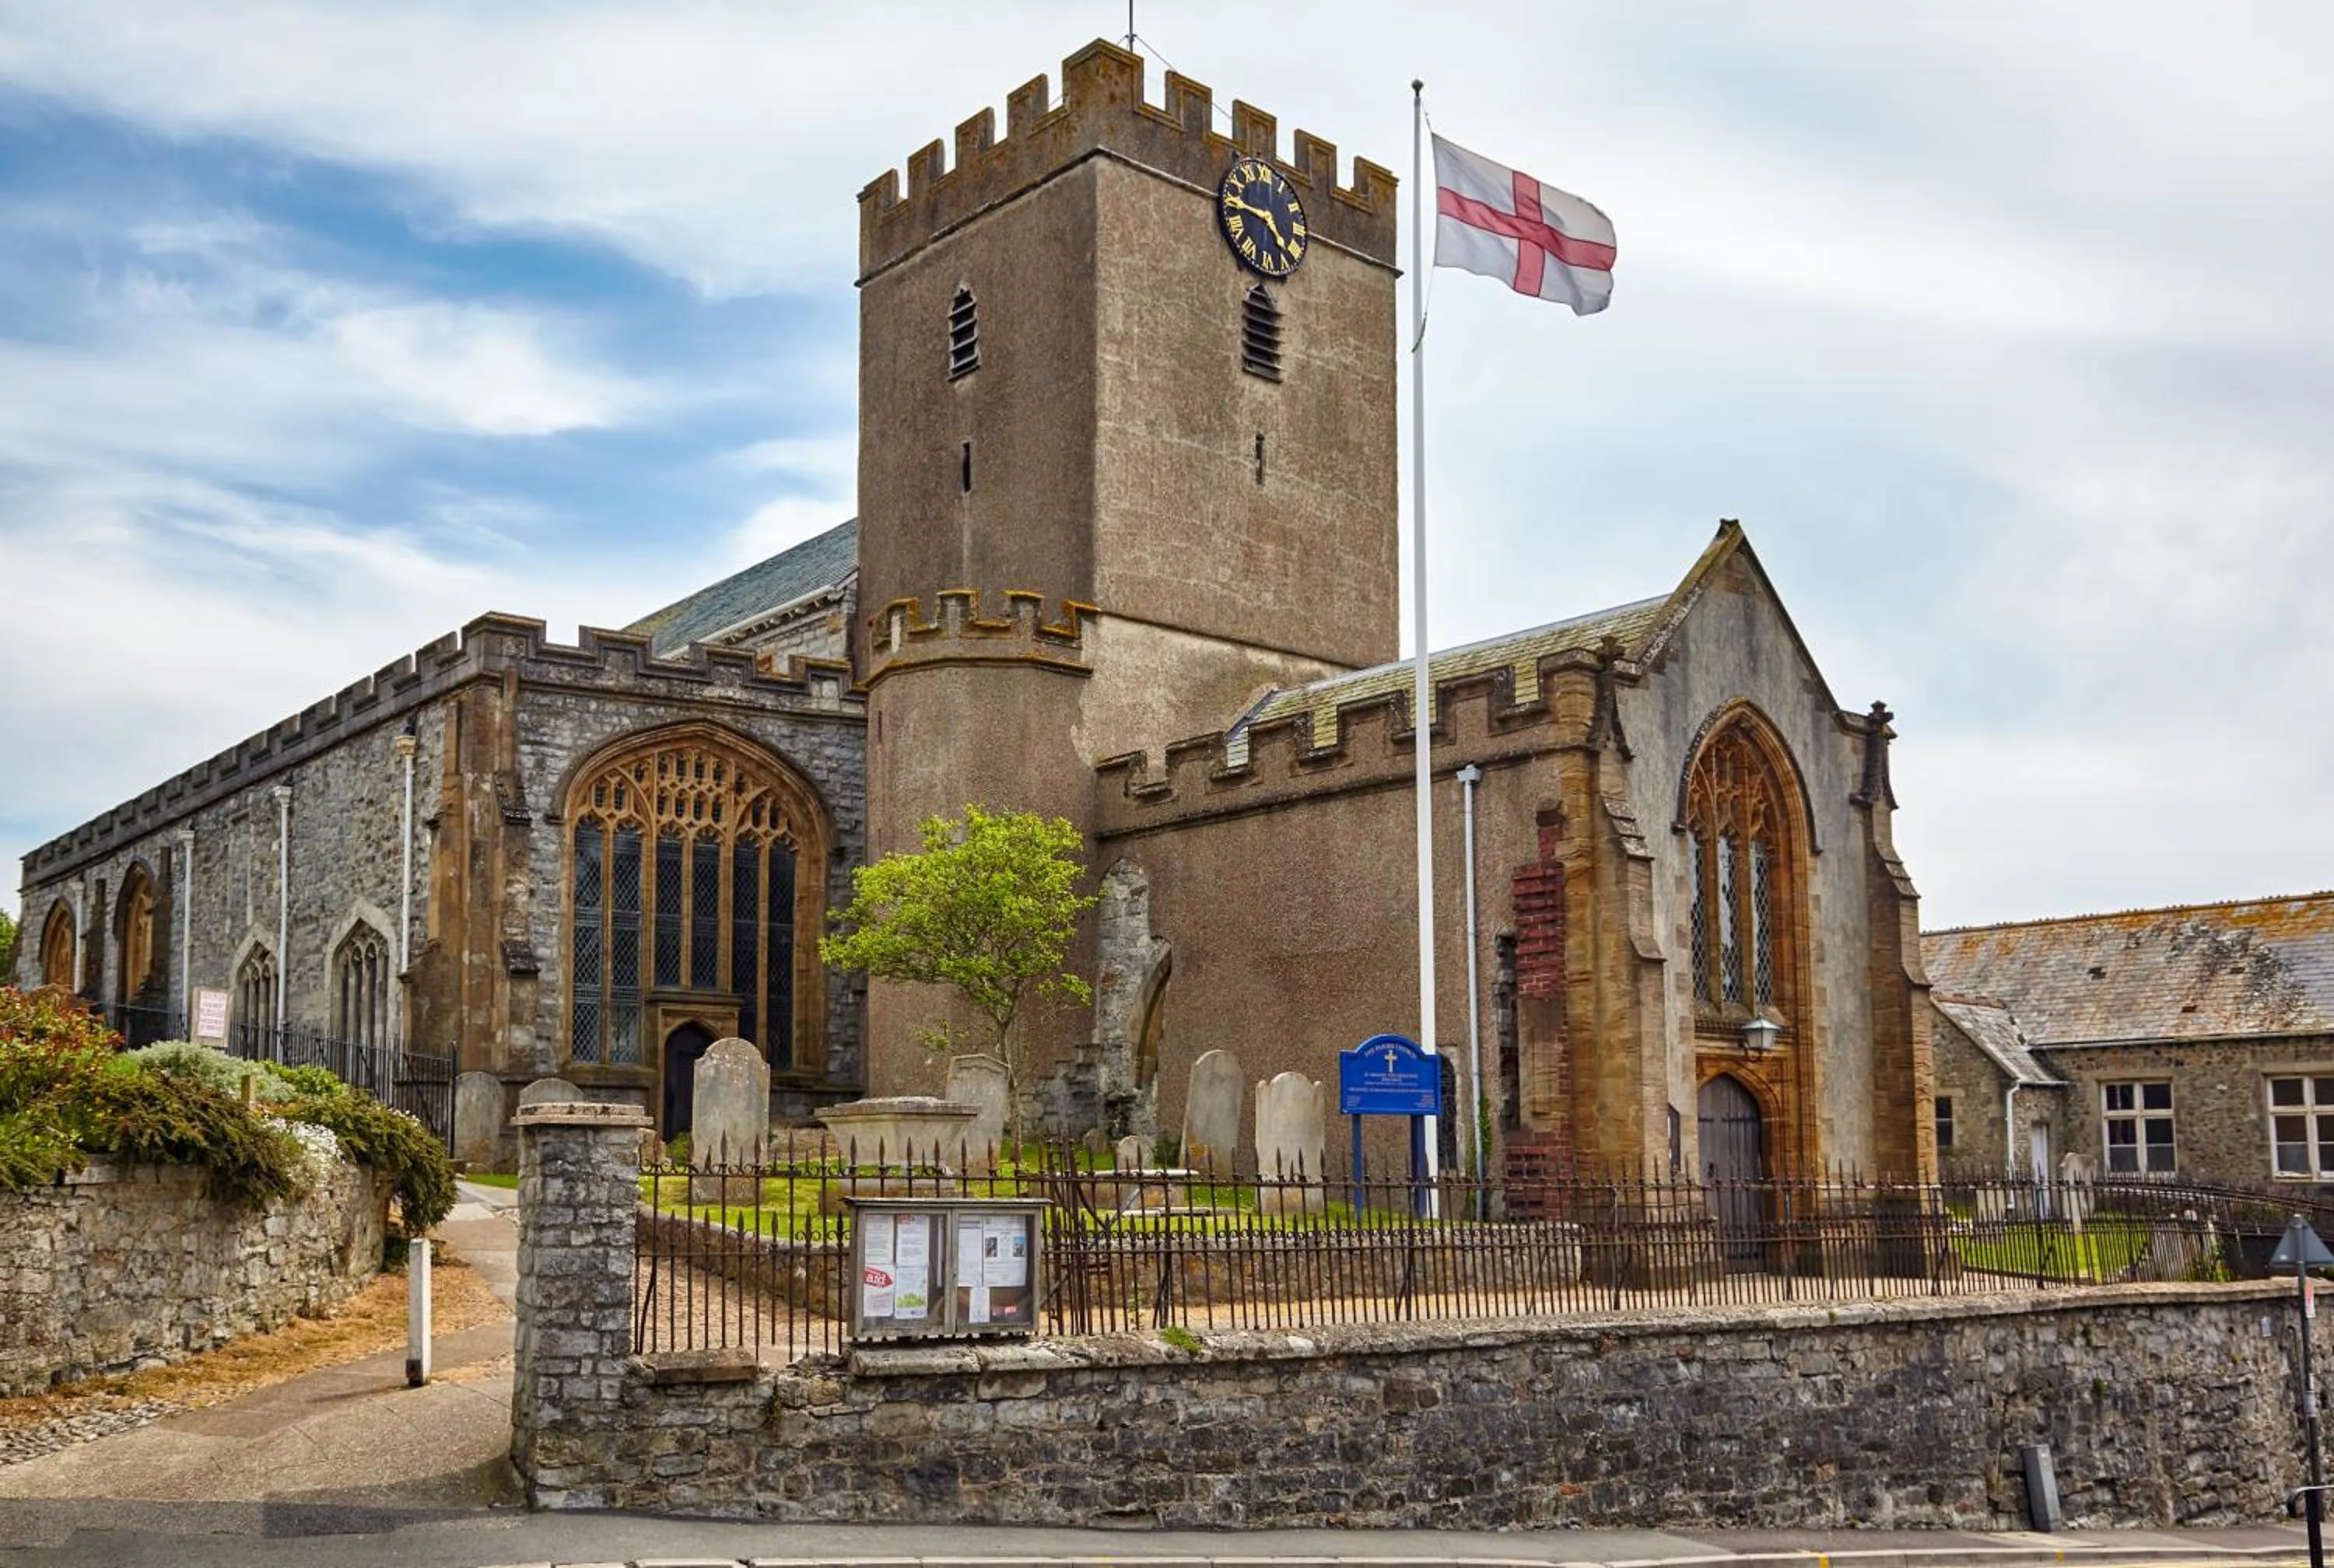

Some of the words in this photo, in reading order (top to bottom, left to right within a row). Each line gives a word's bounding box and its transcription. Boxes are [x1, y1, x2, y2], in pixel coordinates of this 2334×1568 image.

[1257, 165, 1272, 184] XII
[1288, 202, 1301, 213] II
[1228, 214, 1245, 239] VIII
[1292, 221, 1306, 237] III
[1241, 236, 1256, 260] VII
[1261, 250, 1274, 270] VI
[1280, 252, 1291, 270] V
